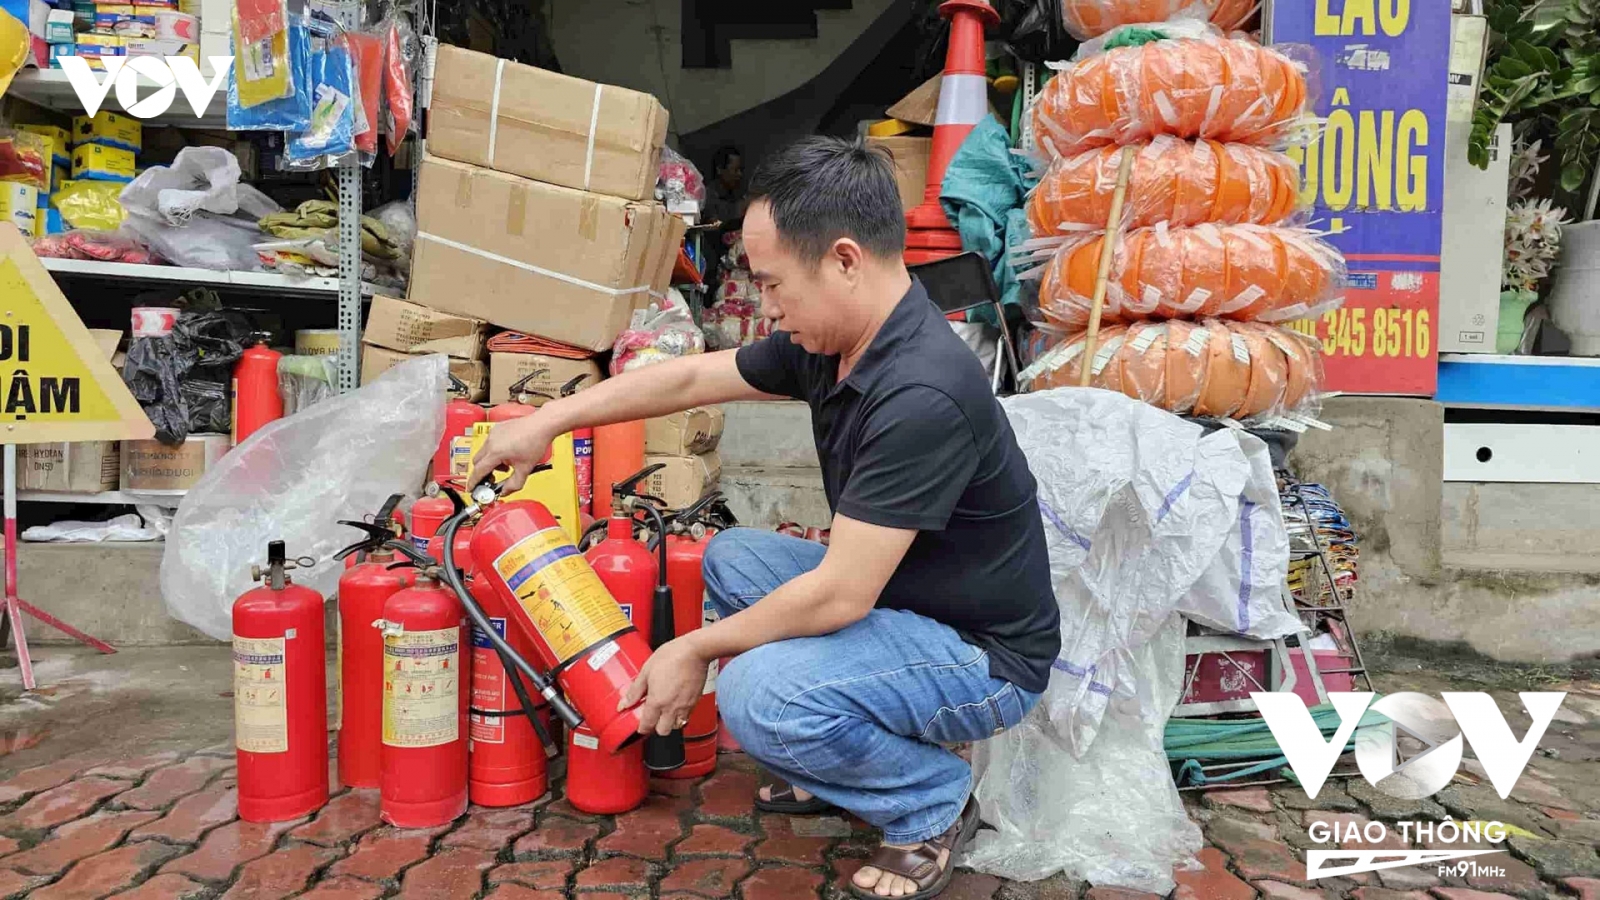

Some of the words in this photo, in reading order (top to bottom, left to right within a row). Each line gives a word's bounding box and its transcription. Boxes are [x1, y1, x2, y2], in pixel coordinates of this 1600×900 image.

[1323, 307, 1366, 356] 345
[1373, 307, 1430, 358] 8516
[0, 369, 80, 420] ẬM
